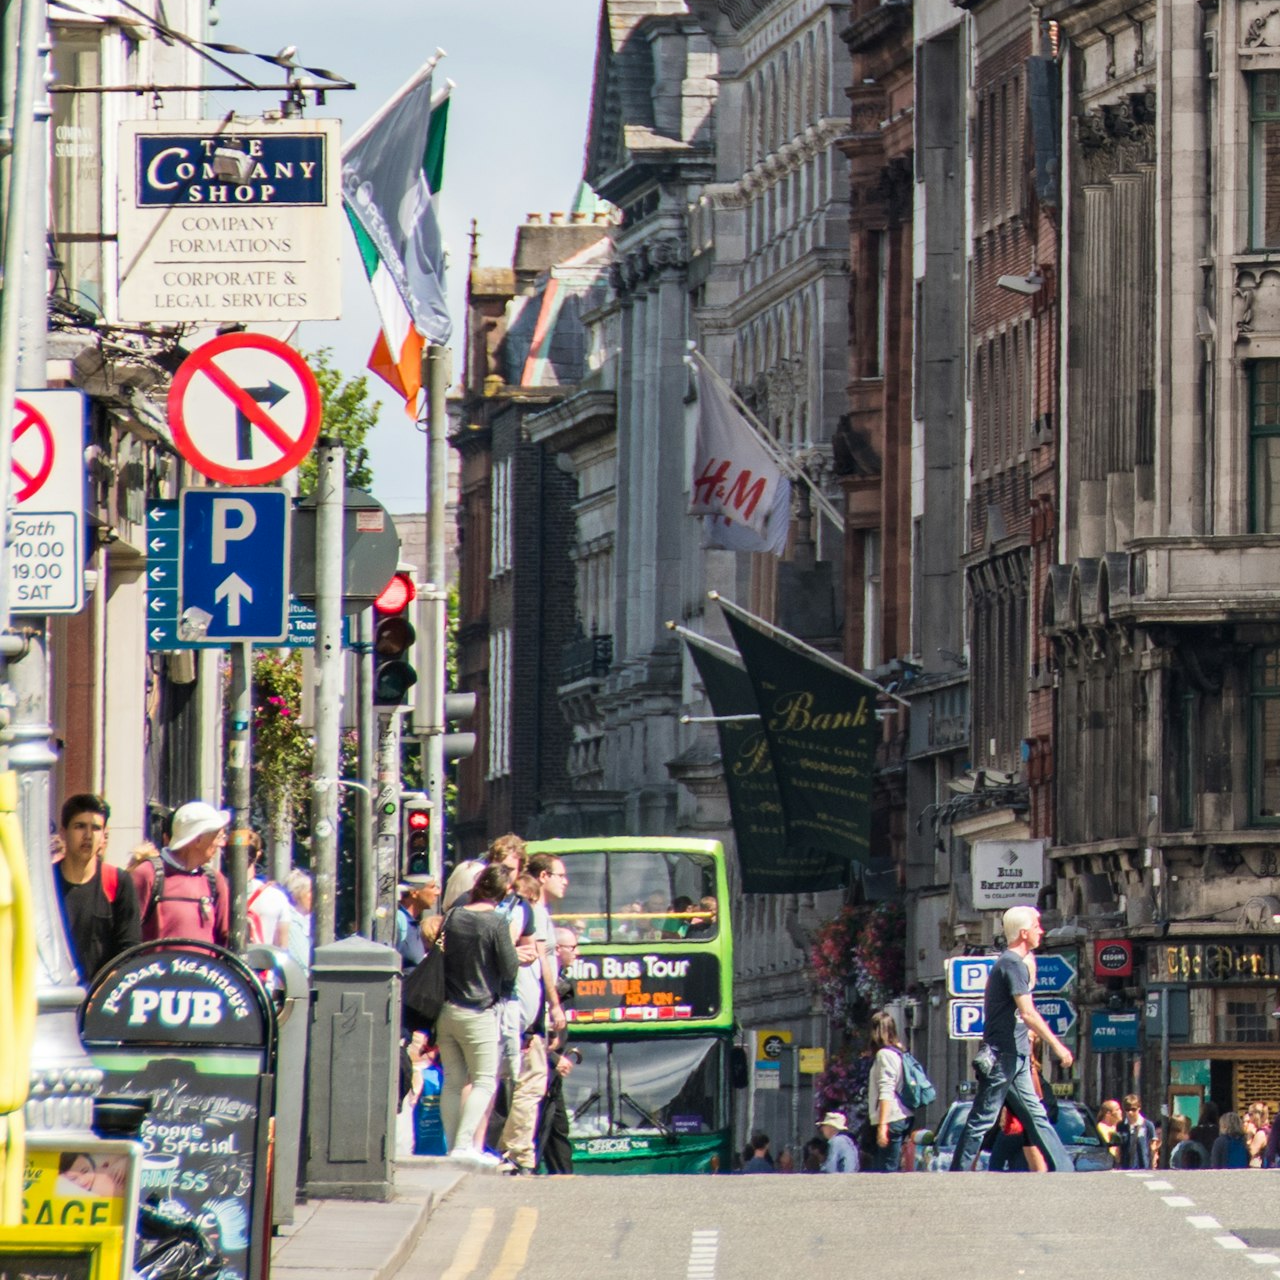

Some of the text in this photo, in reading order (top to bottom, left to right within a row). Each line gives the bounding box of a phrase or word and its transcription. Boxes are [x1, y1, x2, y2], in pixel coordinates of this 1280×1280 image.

[201, 140, 263, 156] TE
[147, 147, 316, 191] COMANY
[188, 185, 276, 202] SHOP
[181, 217, 278, 232] COMPANY
[169, 238, 292, 253] FORMATIONS
[163, 270, 297, 287] CORPORATE &
[154, 293, 307, 308] LEGAL SERVICES
[14, 521, 56, 536] Sath
[211, 498, 257, 564] P
[13, 541, 65, 557] 10.00
[12, 563, 62, 579] 19.00
[17, 584, 53, 600] SAT
[769, 691, 868, 731] Bank
[777, 736, 830, 754] COLLEGE
[834, 747, 869, 760] GREEN
[997, 867, 1024, 878] ELLIS
[980, 880, 1040, 890] EMPLOYMENT
[602, 956, 690, 979] Bus Tour
[1167, 946, 1201, 976] The
[967, 968, 983, 987] P
[577, 980, 608, 995] CITY
[129, 990, 222, 1024] PUB
[961, 1007, 981, 1033] P
[1094, 1027, 1117, 1036] ATM
[162, 1132, 239, 1155] SPECIAL
